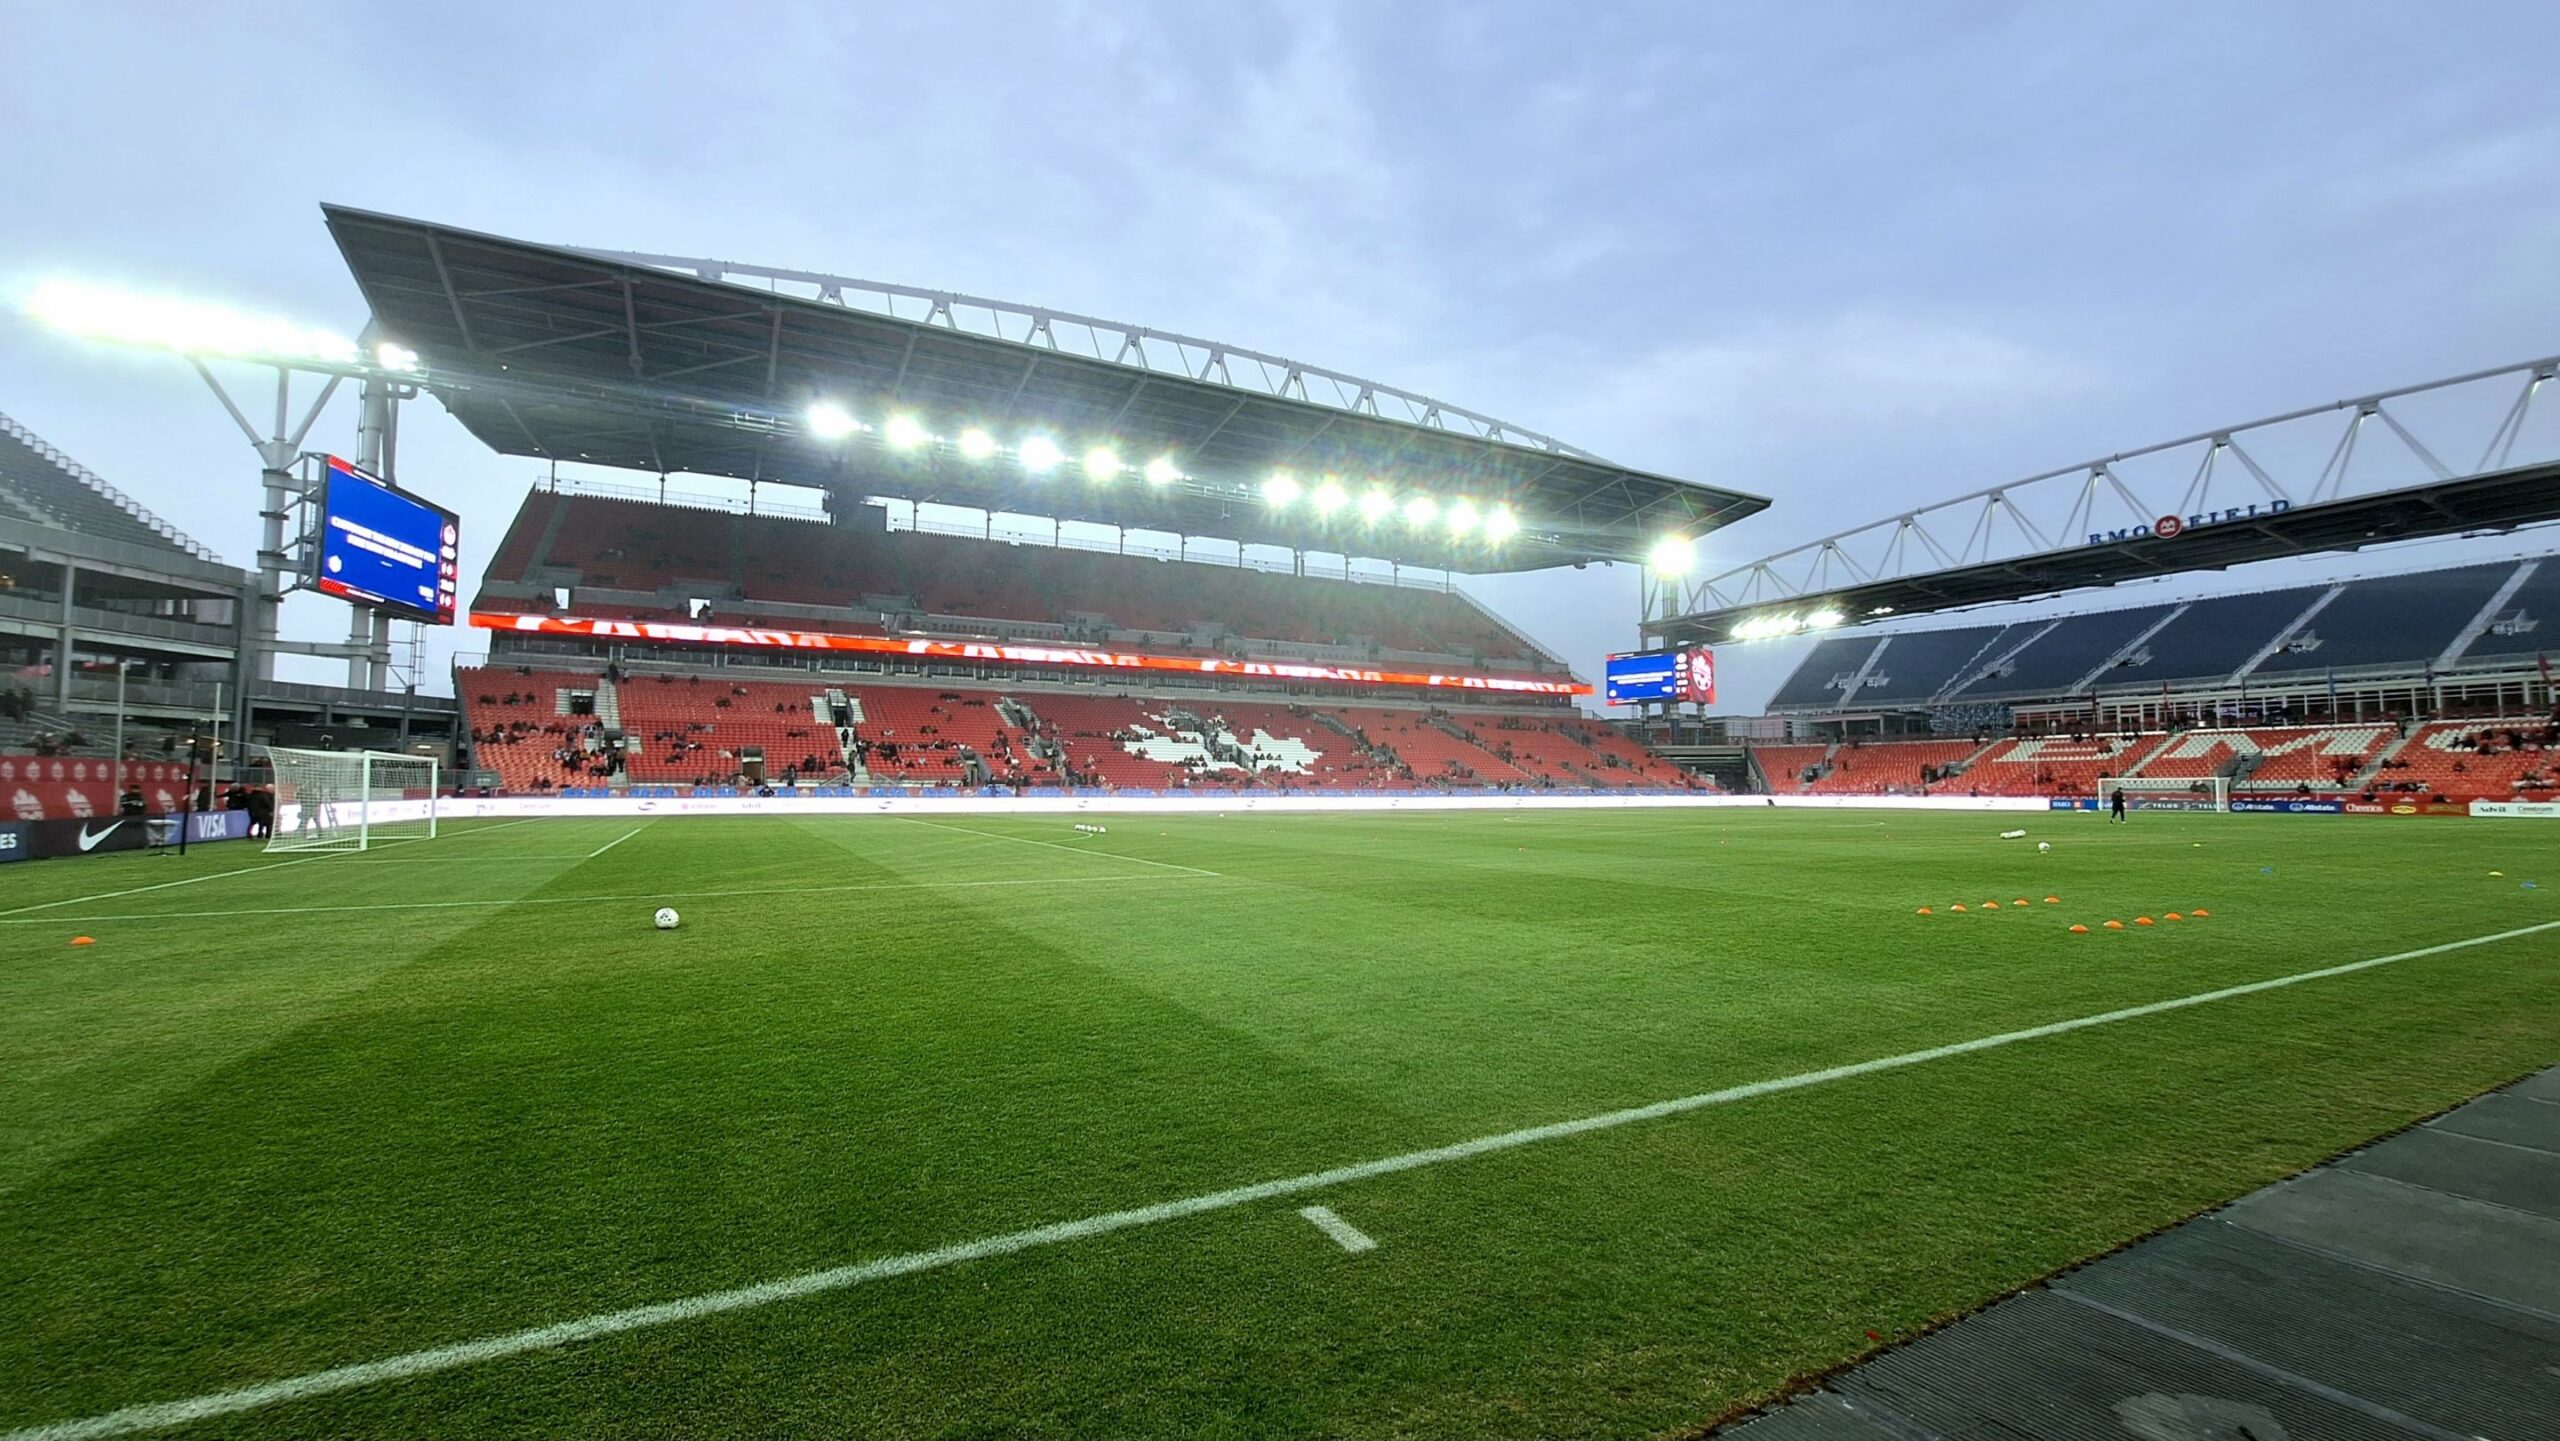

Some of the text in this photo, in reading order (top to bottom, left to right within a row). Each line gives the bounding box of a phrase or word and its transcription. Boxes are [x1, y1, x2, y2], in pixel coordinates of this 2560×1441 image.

[2087, 499, 2291, 546] BMO FIELD
[2244, 803, 2275, 811] Allstate
[2303, 803, 2336, 811] Allstate
[2345, 802, 2384, 813] Cheerios
[2479, 805, 2507, 813] Advil
[197, 814, 227, 838] VISA
